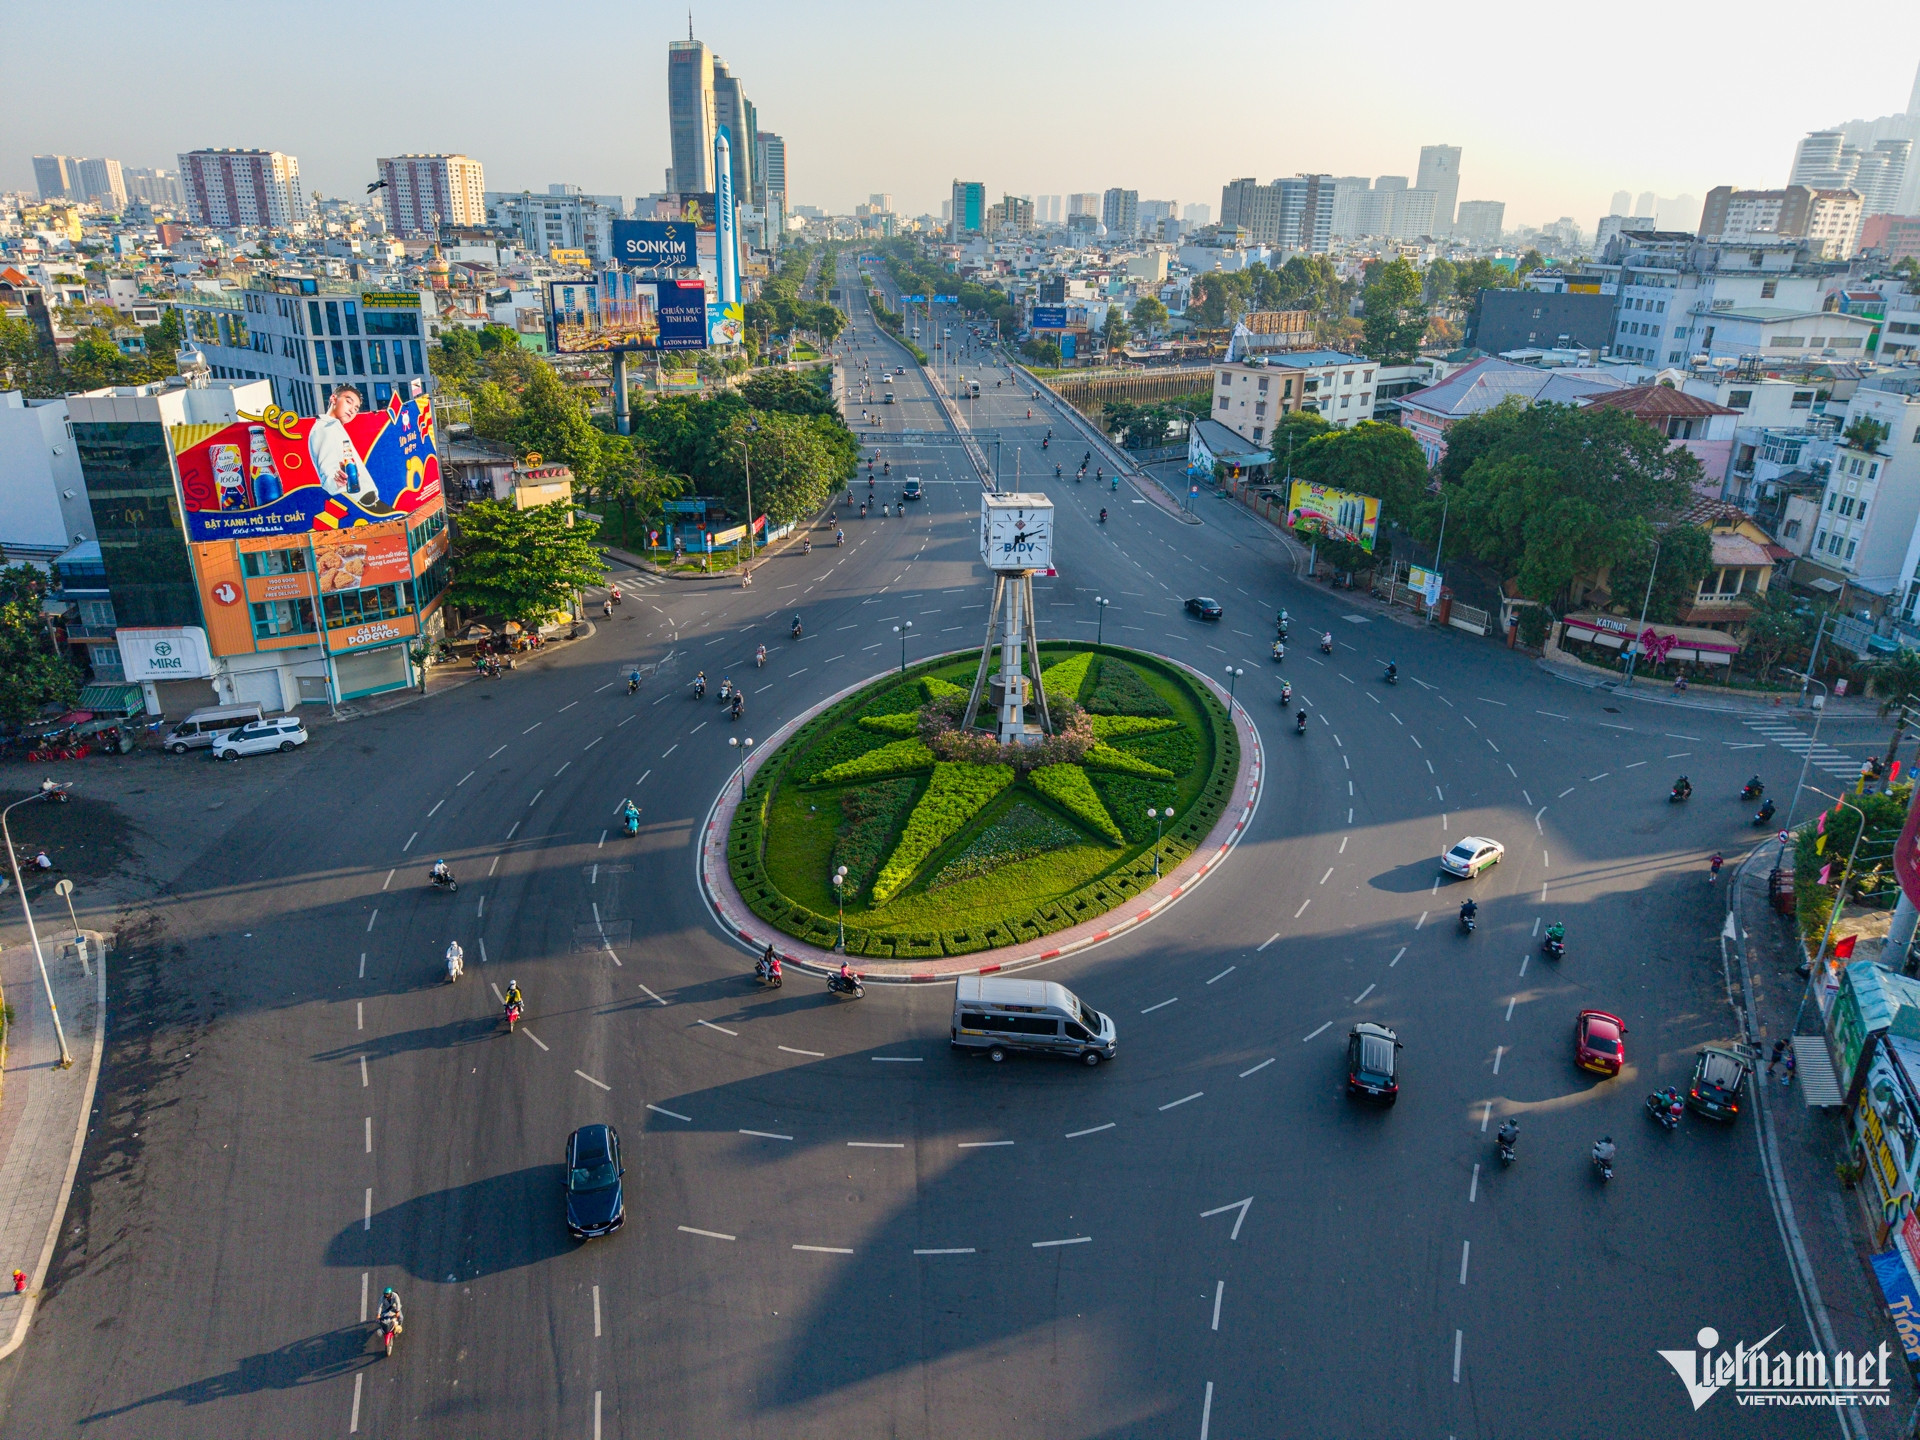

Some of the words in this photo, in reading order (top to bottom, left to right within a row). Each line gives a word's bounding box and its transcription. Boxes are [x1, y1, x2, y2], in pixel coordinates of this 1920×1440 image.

[626, 240, 686, 253] SONKIM
[659, 254, 687, 263] LAND
[683, 315, 698, 323] HOA
[220, 475, 239, 483] 1664
[204, 519, 221, 530] BẬT
[266, 512, 282, 524] TẾT
[1004, 543, 1035, 553] BIDV
[357, 625, 370, 635] GÀ
[370, 622, 388, 633] RÁN
[1596, 617, 1628, 633] KATINAT
[149, 657, 182, 669] MIRA
